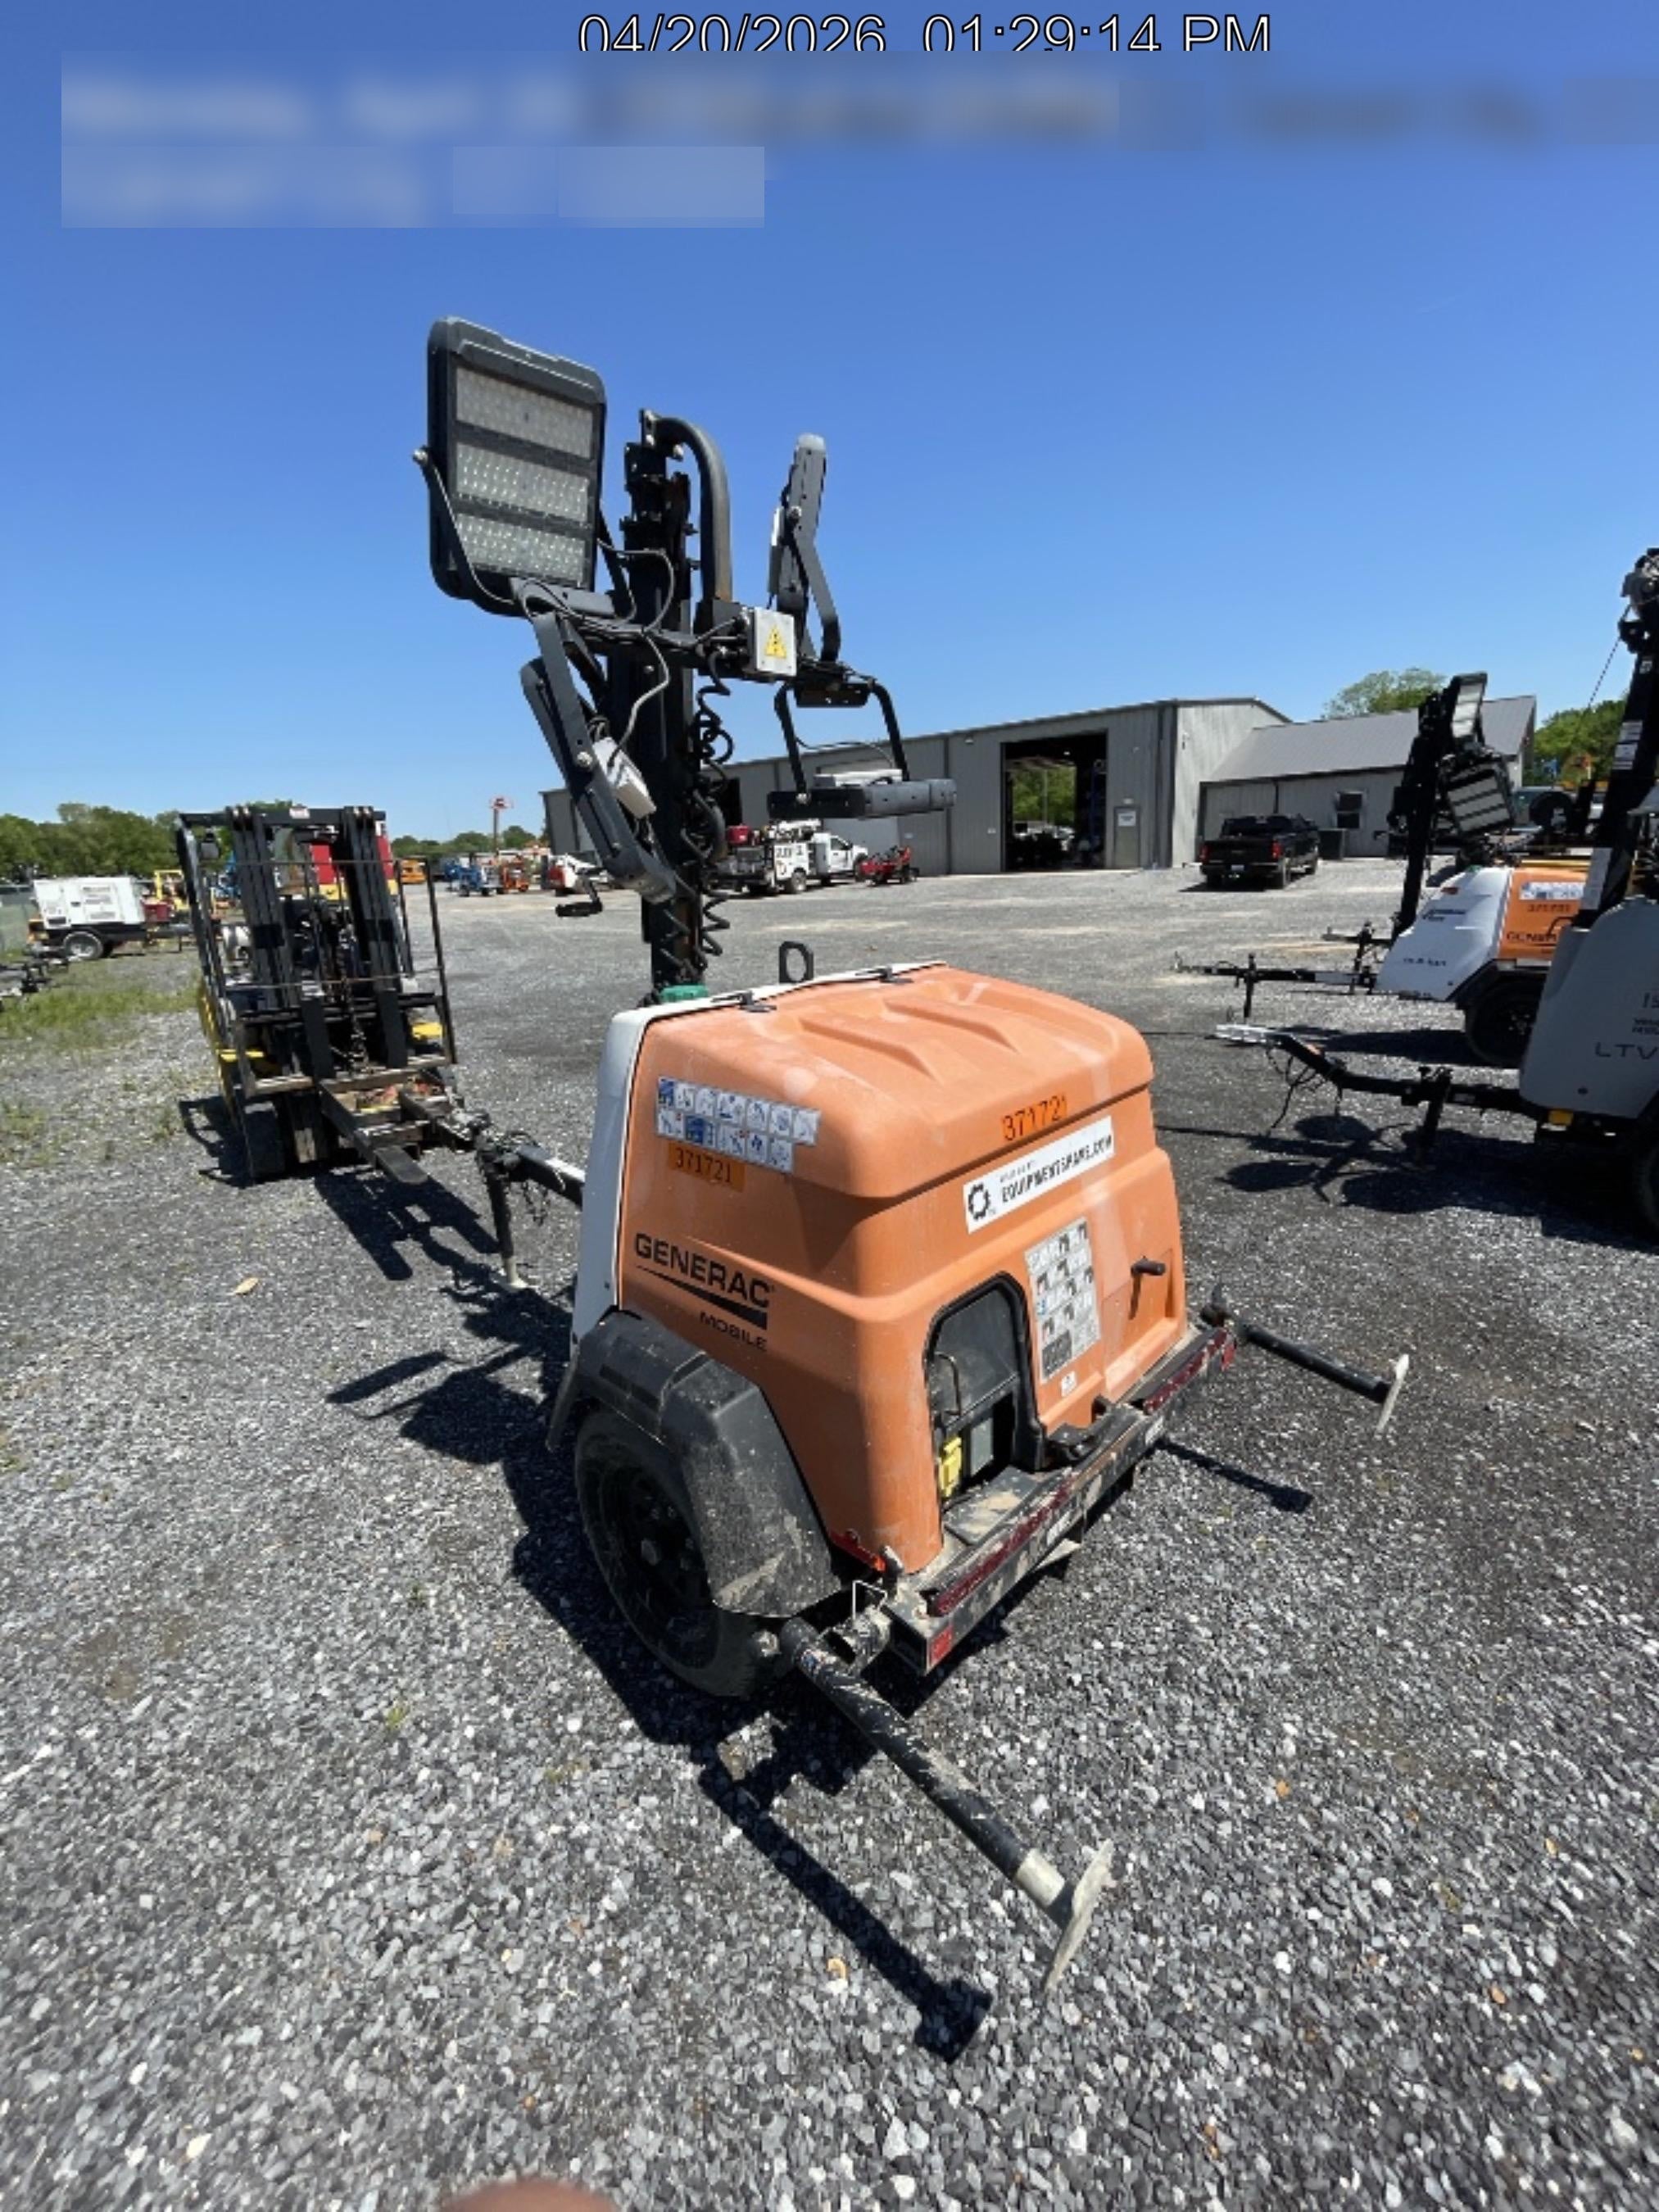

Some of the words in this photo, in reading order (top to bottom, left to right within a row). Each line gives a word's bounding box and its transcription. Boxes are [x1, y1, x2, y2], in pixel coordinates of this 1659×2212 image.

[1001, 1093, 1067, 1141] 371721
[676, 1147, 732, 1184] 371721
[634, 1232, 770, 1308] GENERAC
[700, 1311, 767, 1352] MOBILE
